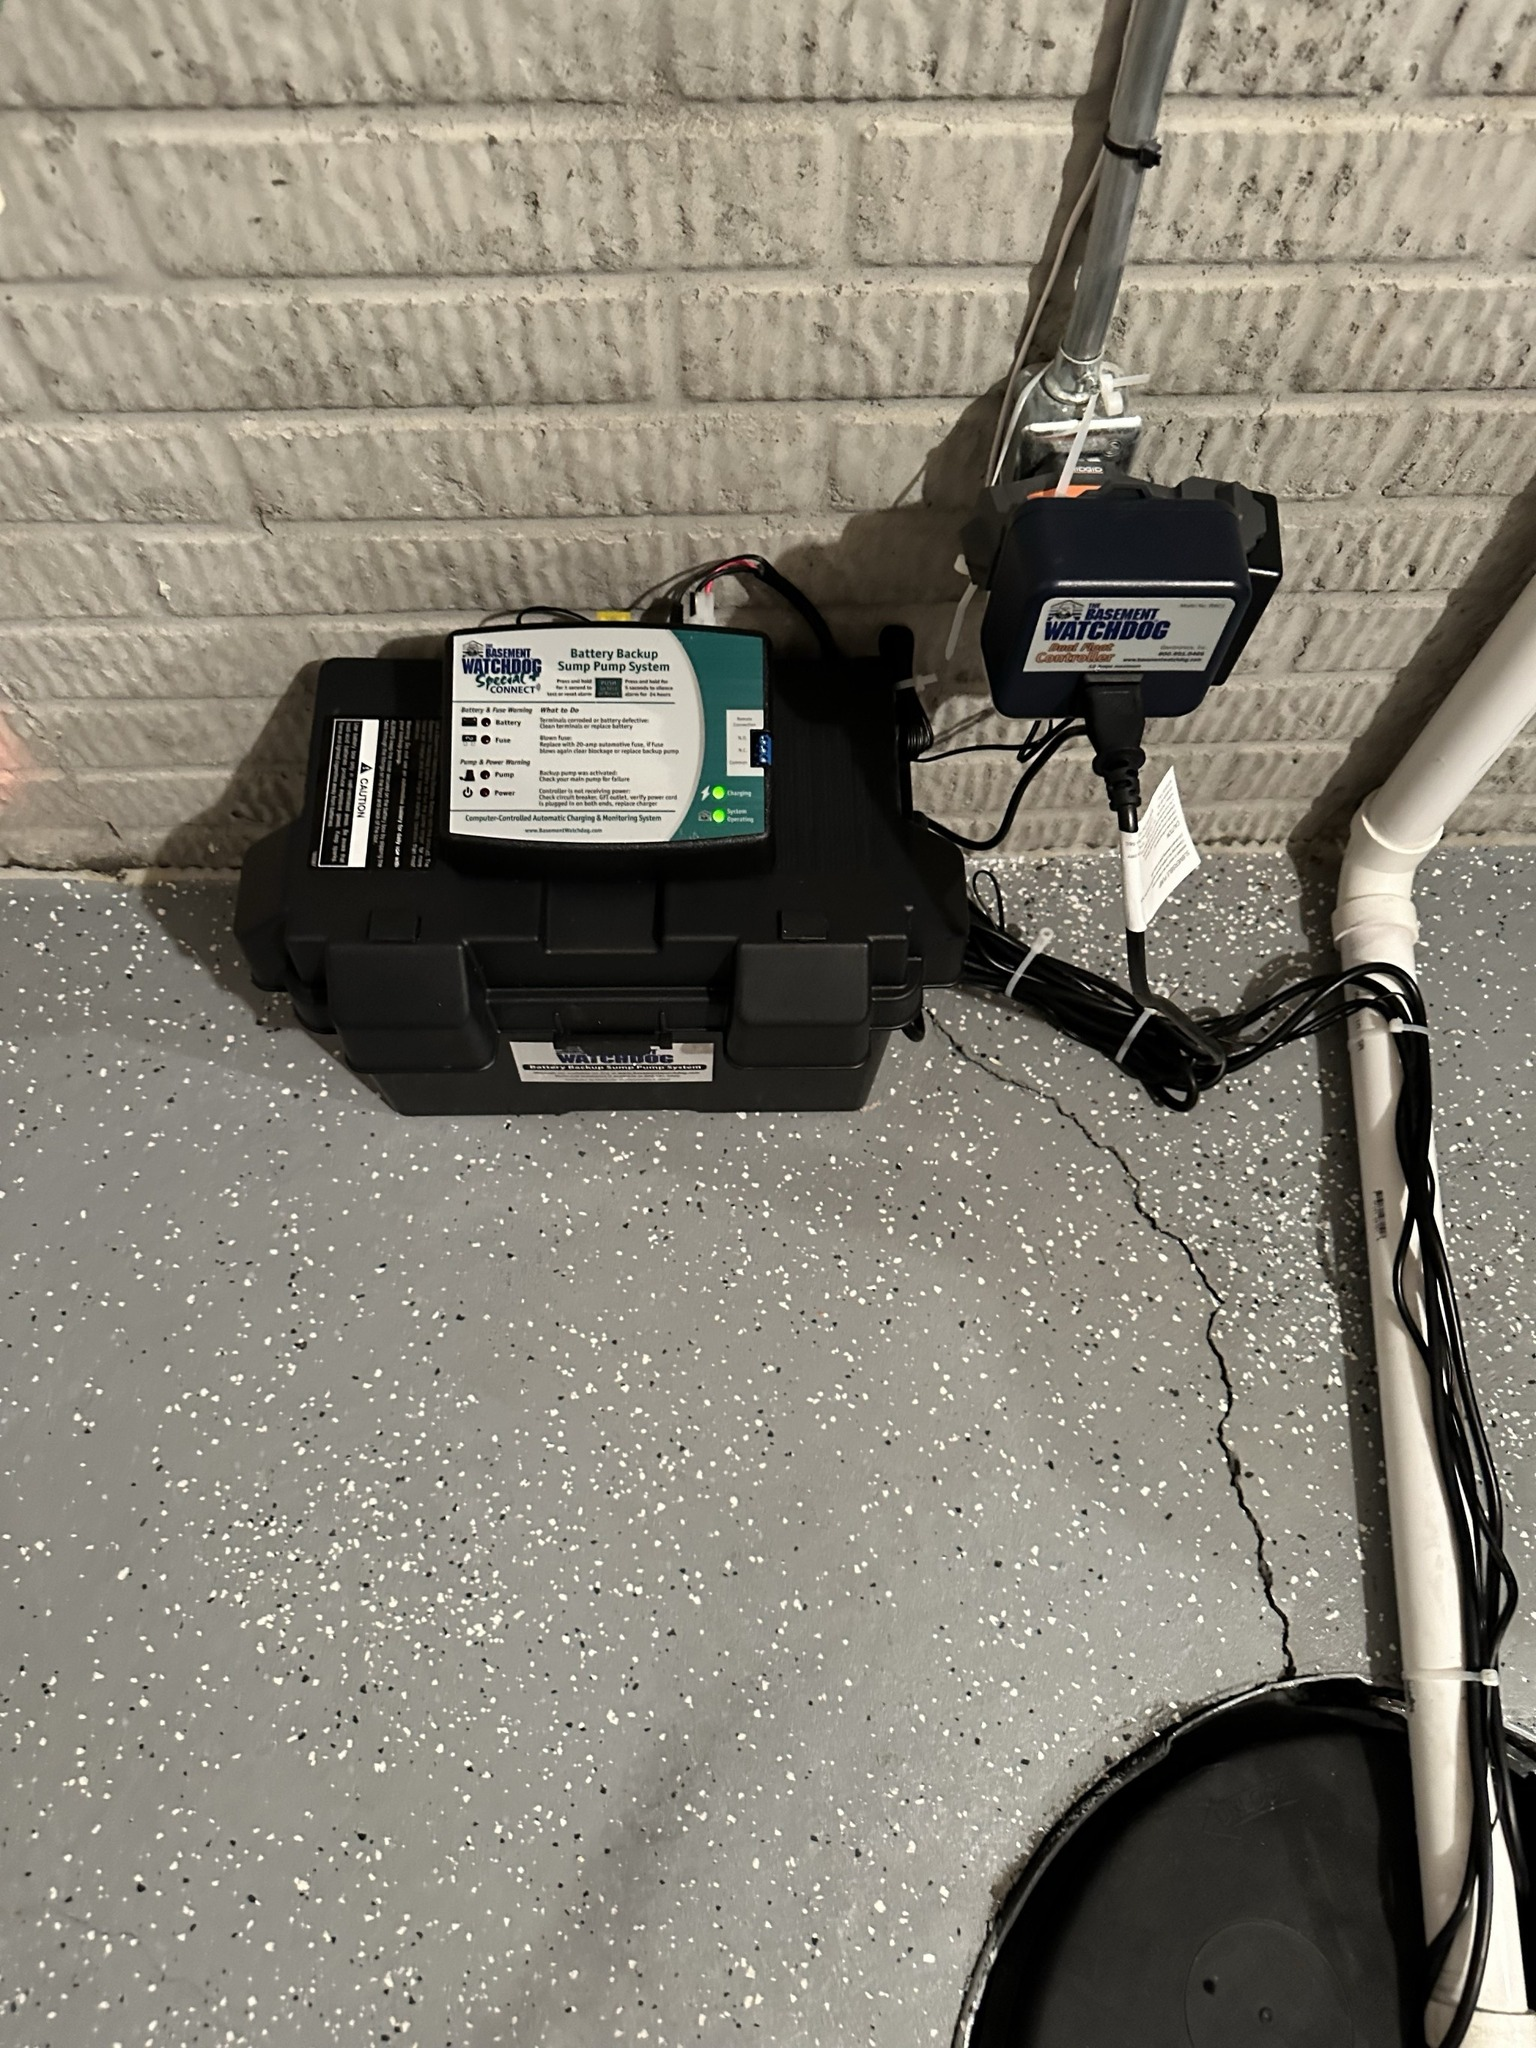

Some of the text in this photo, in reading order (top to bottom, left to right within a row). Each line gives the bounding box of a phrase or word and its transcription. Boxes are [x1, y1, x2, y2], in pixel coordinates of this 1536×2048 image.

[1084, 608, 1160, 620] BASEMENT
[1044, 621, 1171, 640] WATCHDOG
[1048, 642, 1115, 652] Dual Float
[485, 648, 531, 658] BASEMENT
[570, 648, 658, 660] Battery Backup
[1035, 652, 1116, 663] Controller
[462, 658, 542, 674] WATCHDOG
[558, 661, 670, 674] Sump Pump System
[490, 685, 535, 694] CONNECT
[508, 707, 533, 715] Warning
[495, 719, 521, 727] Battery
[357, 778, 369, 818] CAUTION
[465, 815, 532, 823] Computer-Controlled
[566, 815, 595, 823] Charging
[602, 815, 638, 823] Monitoring
